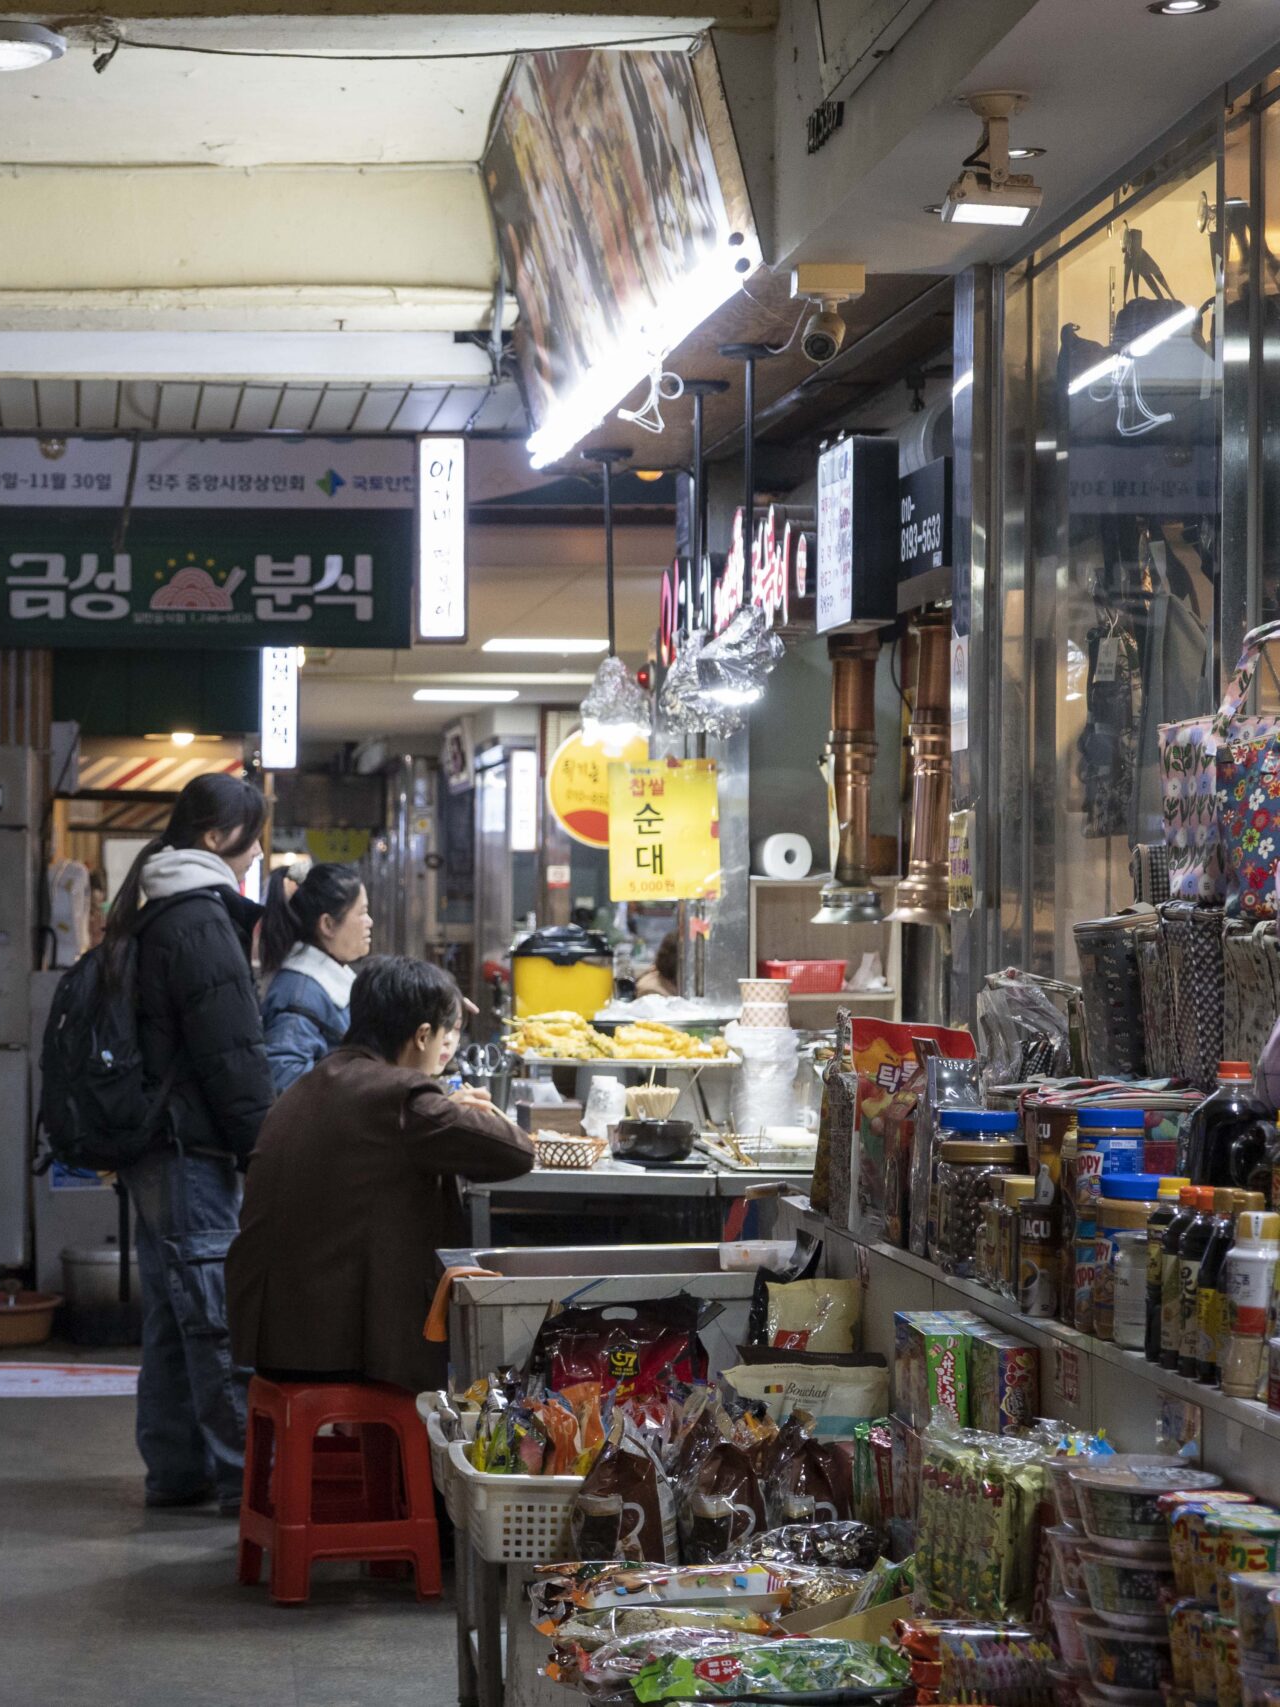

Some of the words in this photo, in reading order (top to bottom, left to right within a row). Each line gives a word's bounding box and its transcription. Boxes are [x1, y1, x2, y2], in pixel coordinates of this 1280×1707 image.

[73, 472, 111, 491] 30일
[146, 473, 179, 491] 진주
[901, 495, 915, 525] 010-
[901, 512, 941, 563] 8193-5633
[6, 552, 132, 620] 금성
[251, 553, 373, 622] 분식
[630, 777, 665, 797] 찹쌀
[633, 803, 665, 875] 순대
[629, 880, 675, 893] 5,000원
[610, 1351, 638, 1368] G7
[786, 1382, 829, 1399] Bouchar
